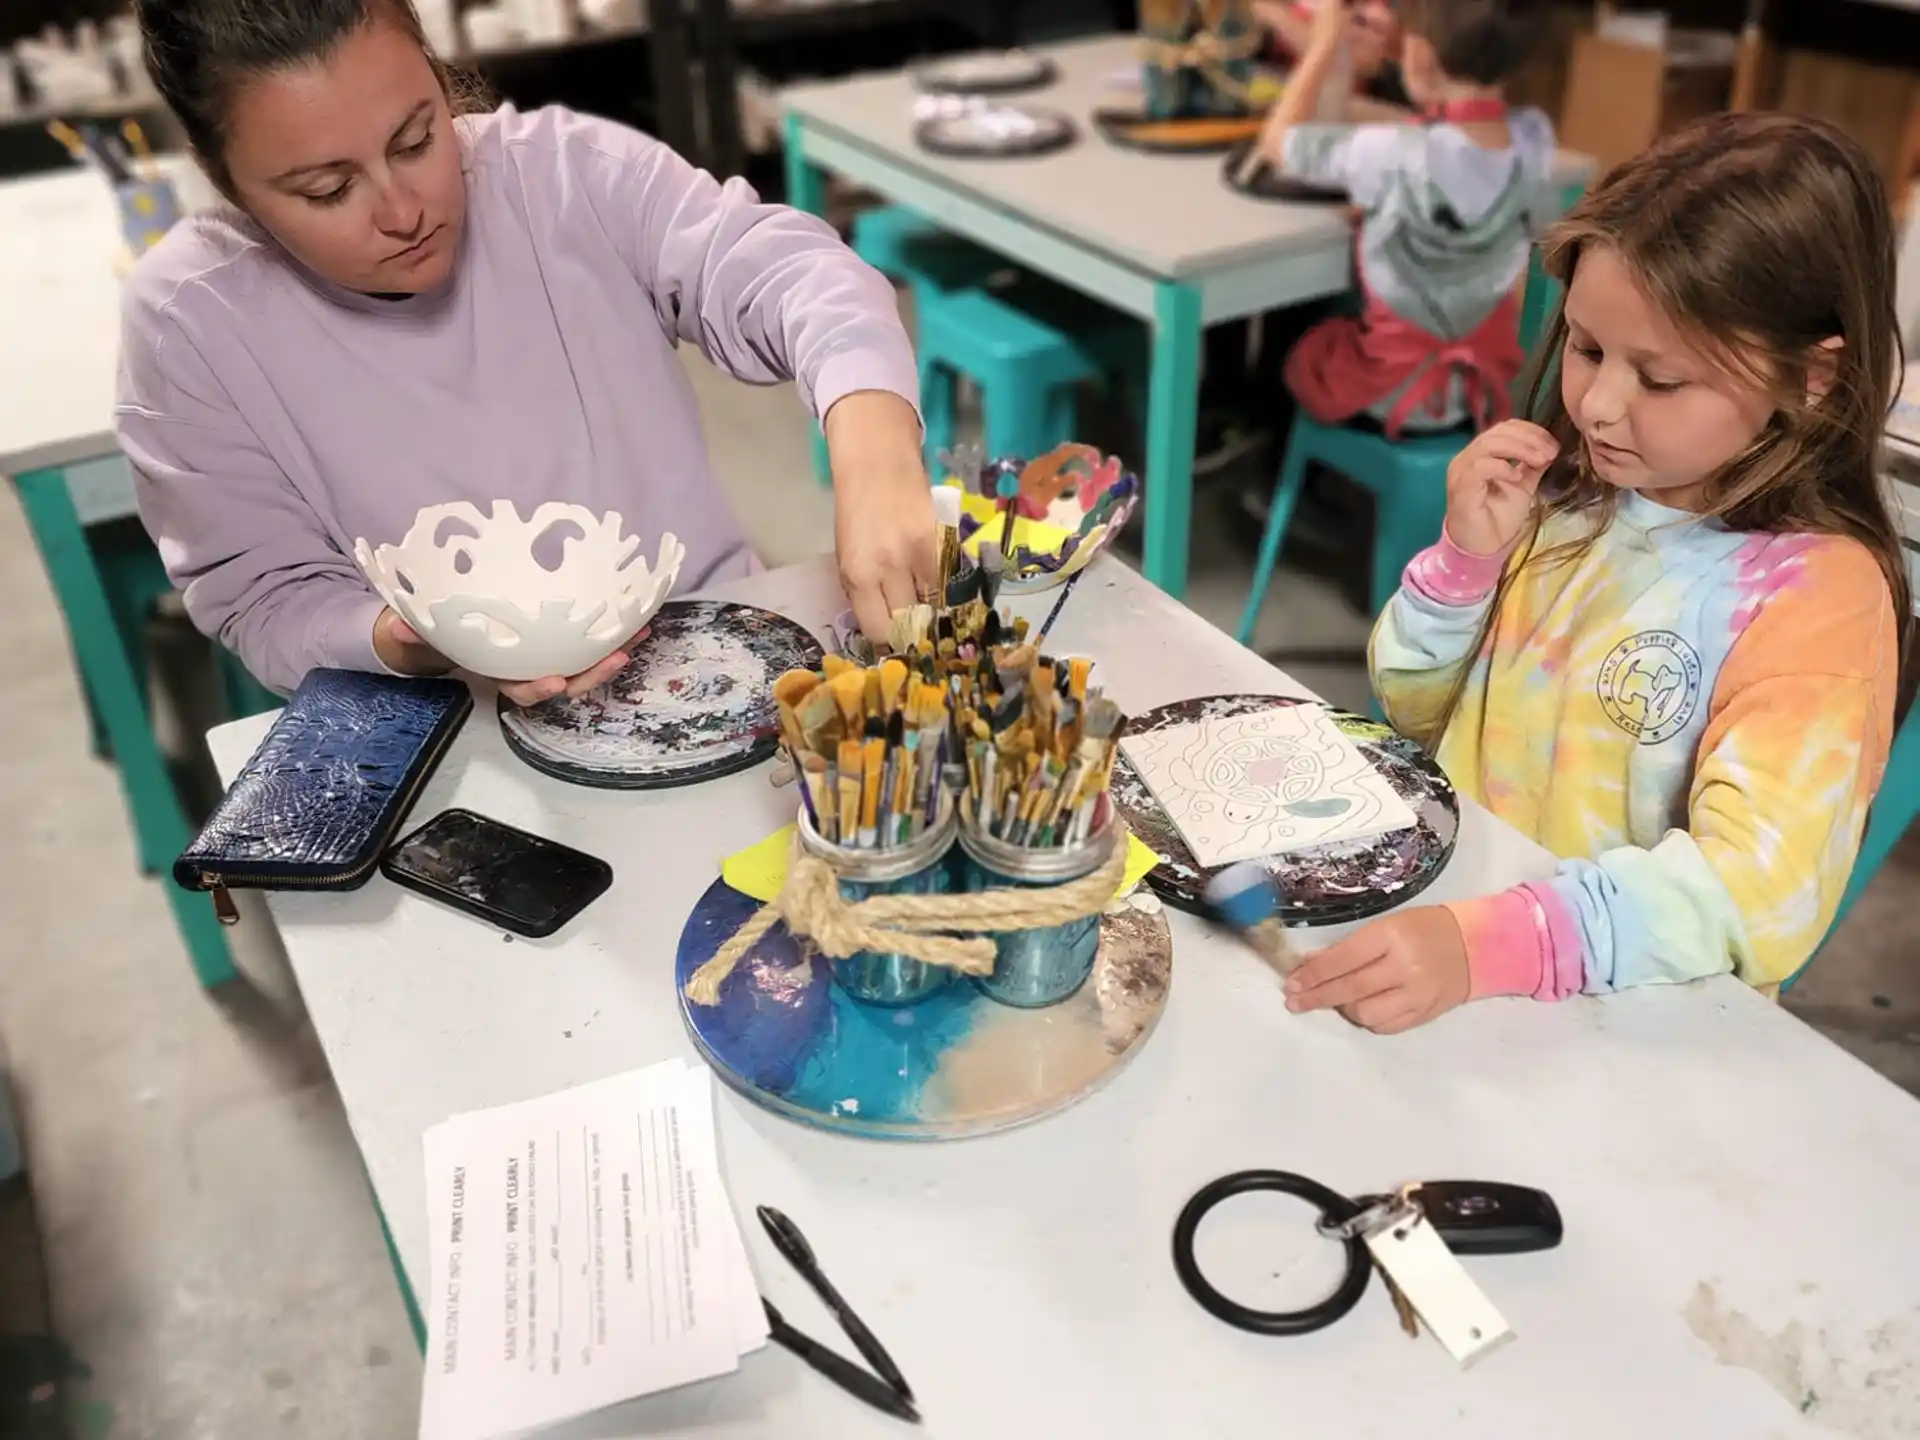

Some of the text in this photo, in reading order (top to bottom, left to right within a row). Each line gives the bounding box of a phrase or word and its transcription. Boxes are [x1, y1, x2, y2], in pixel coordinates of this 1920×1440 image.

[452, 1165, 466, 1208] CLEARLY
[506, 1158, 518, 1199] CLEARLY
[450, 1212, 464, 1243] PRINT
[506, 1203, 518, 1233] PRINT
[444, 1283, 461, 1336] CONTACT
[504, 1270, 518, 1325] CONTACT
[442, 1340, 457, 1374] MAIN
[503, 1327, 517, 1361] MAIN
